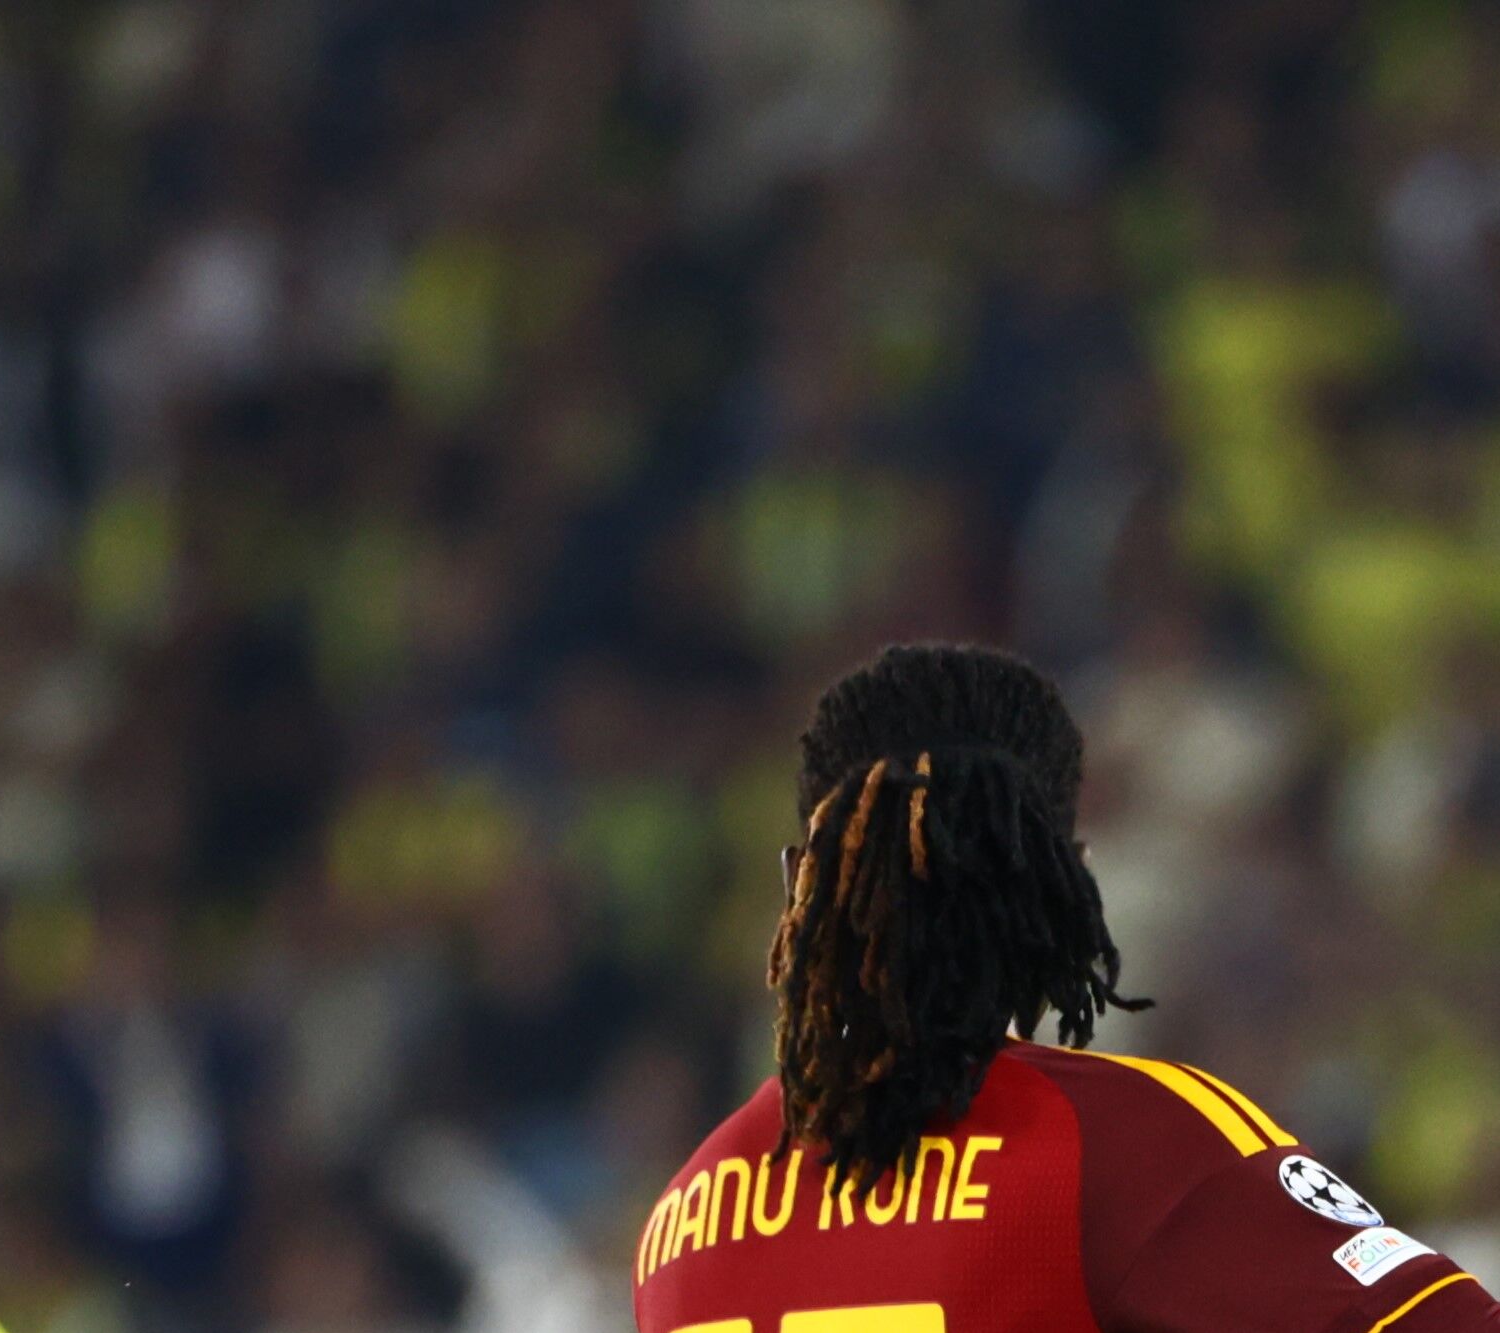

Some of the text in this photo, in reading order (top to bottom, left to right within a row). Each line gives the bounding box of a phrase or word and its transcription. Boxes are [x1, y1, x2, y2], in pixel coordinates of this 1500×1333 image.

[637, 1149, 803, 1287] MANU
[1339, 1238, 1366, 1261] UEFA
[1347, 1236, 1402, 1273] FOUN
